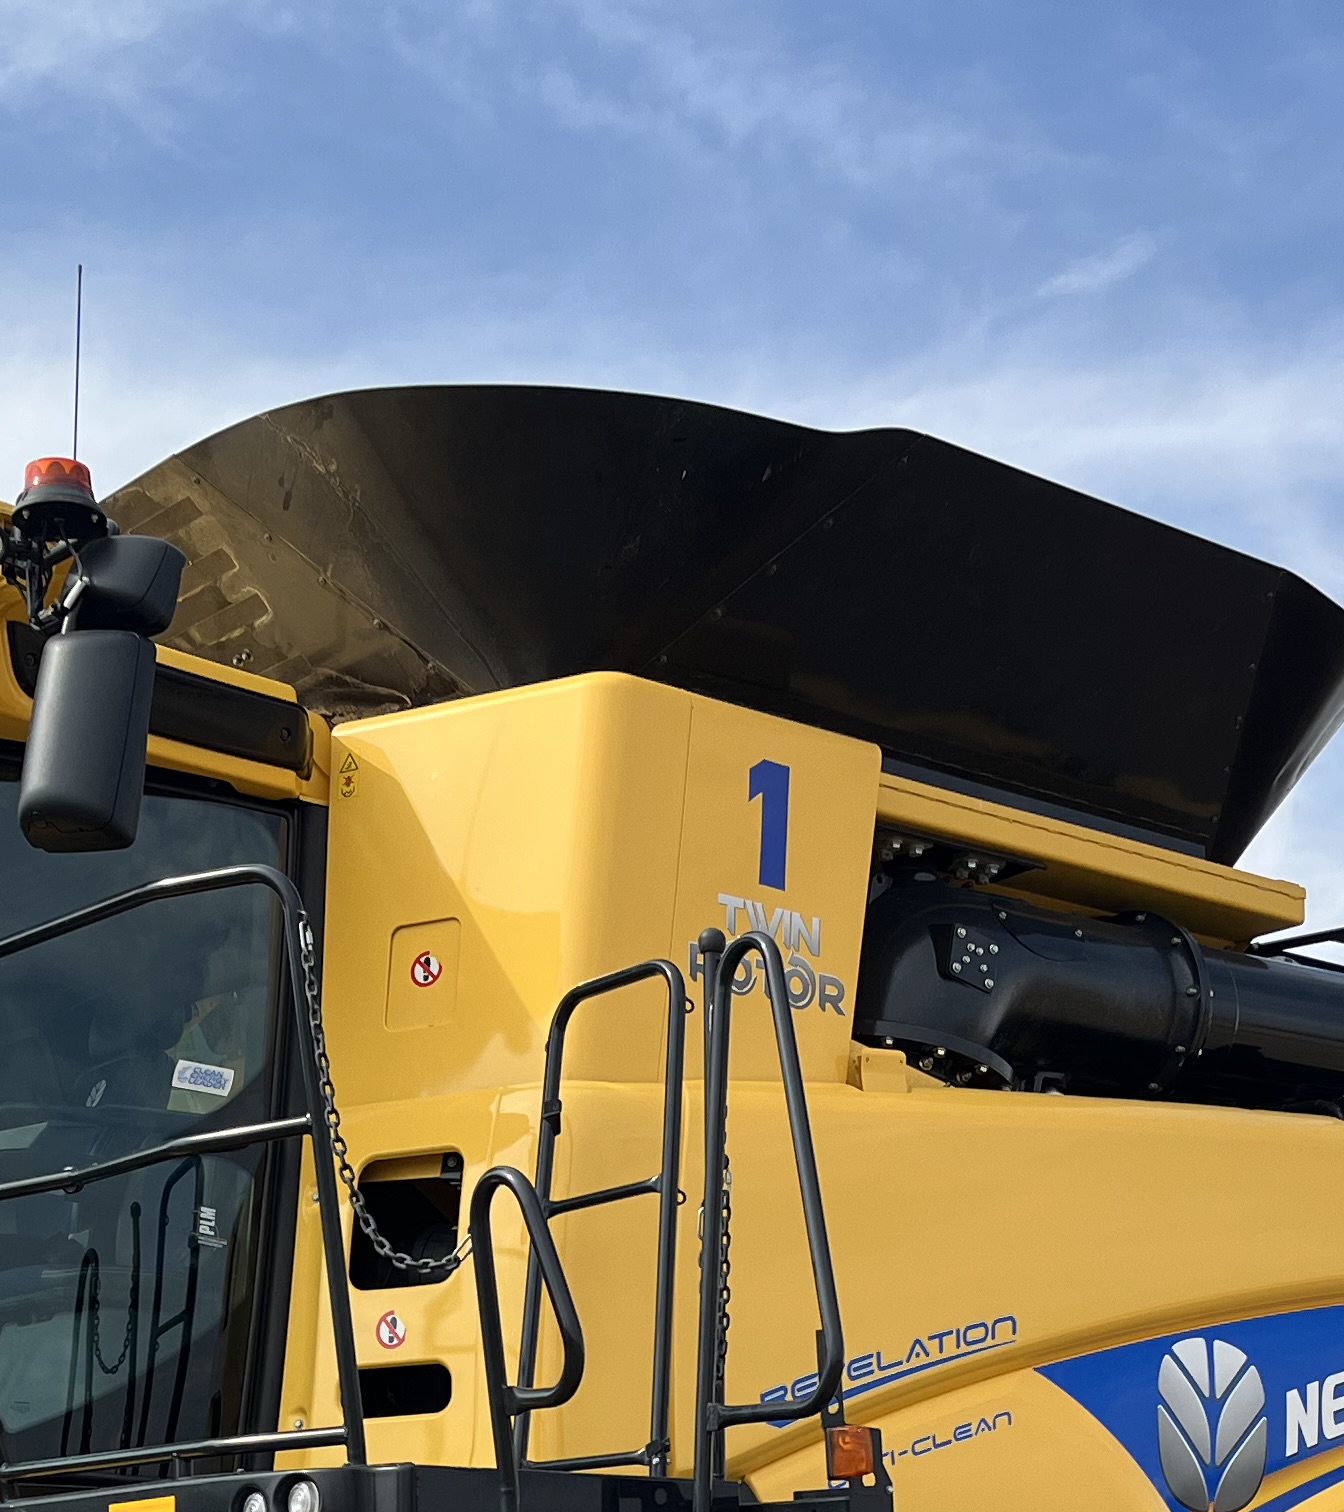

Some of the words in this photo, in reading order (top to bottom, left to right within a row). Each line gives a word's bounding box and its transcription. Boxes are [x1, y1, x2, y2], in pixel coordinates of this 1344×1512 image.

[748, 759, 790, 892] 1
[717, 892, 821, 958] TWIN
[193, 1066, 225, 1079] CLEAN
[198, 1206, 217, 1236] PLM
[760, 1315, 1018, 1405] REELATION
